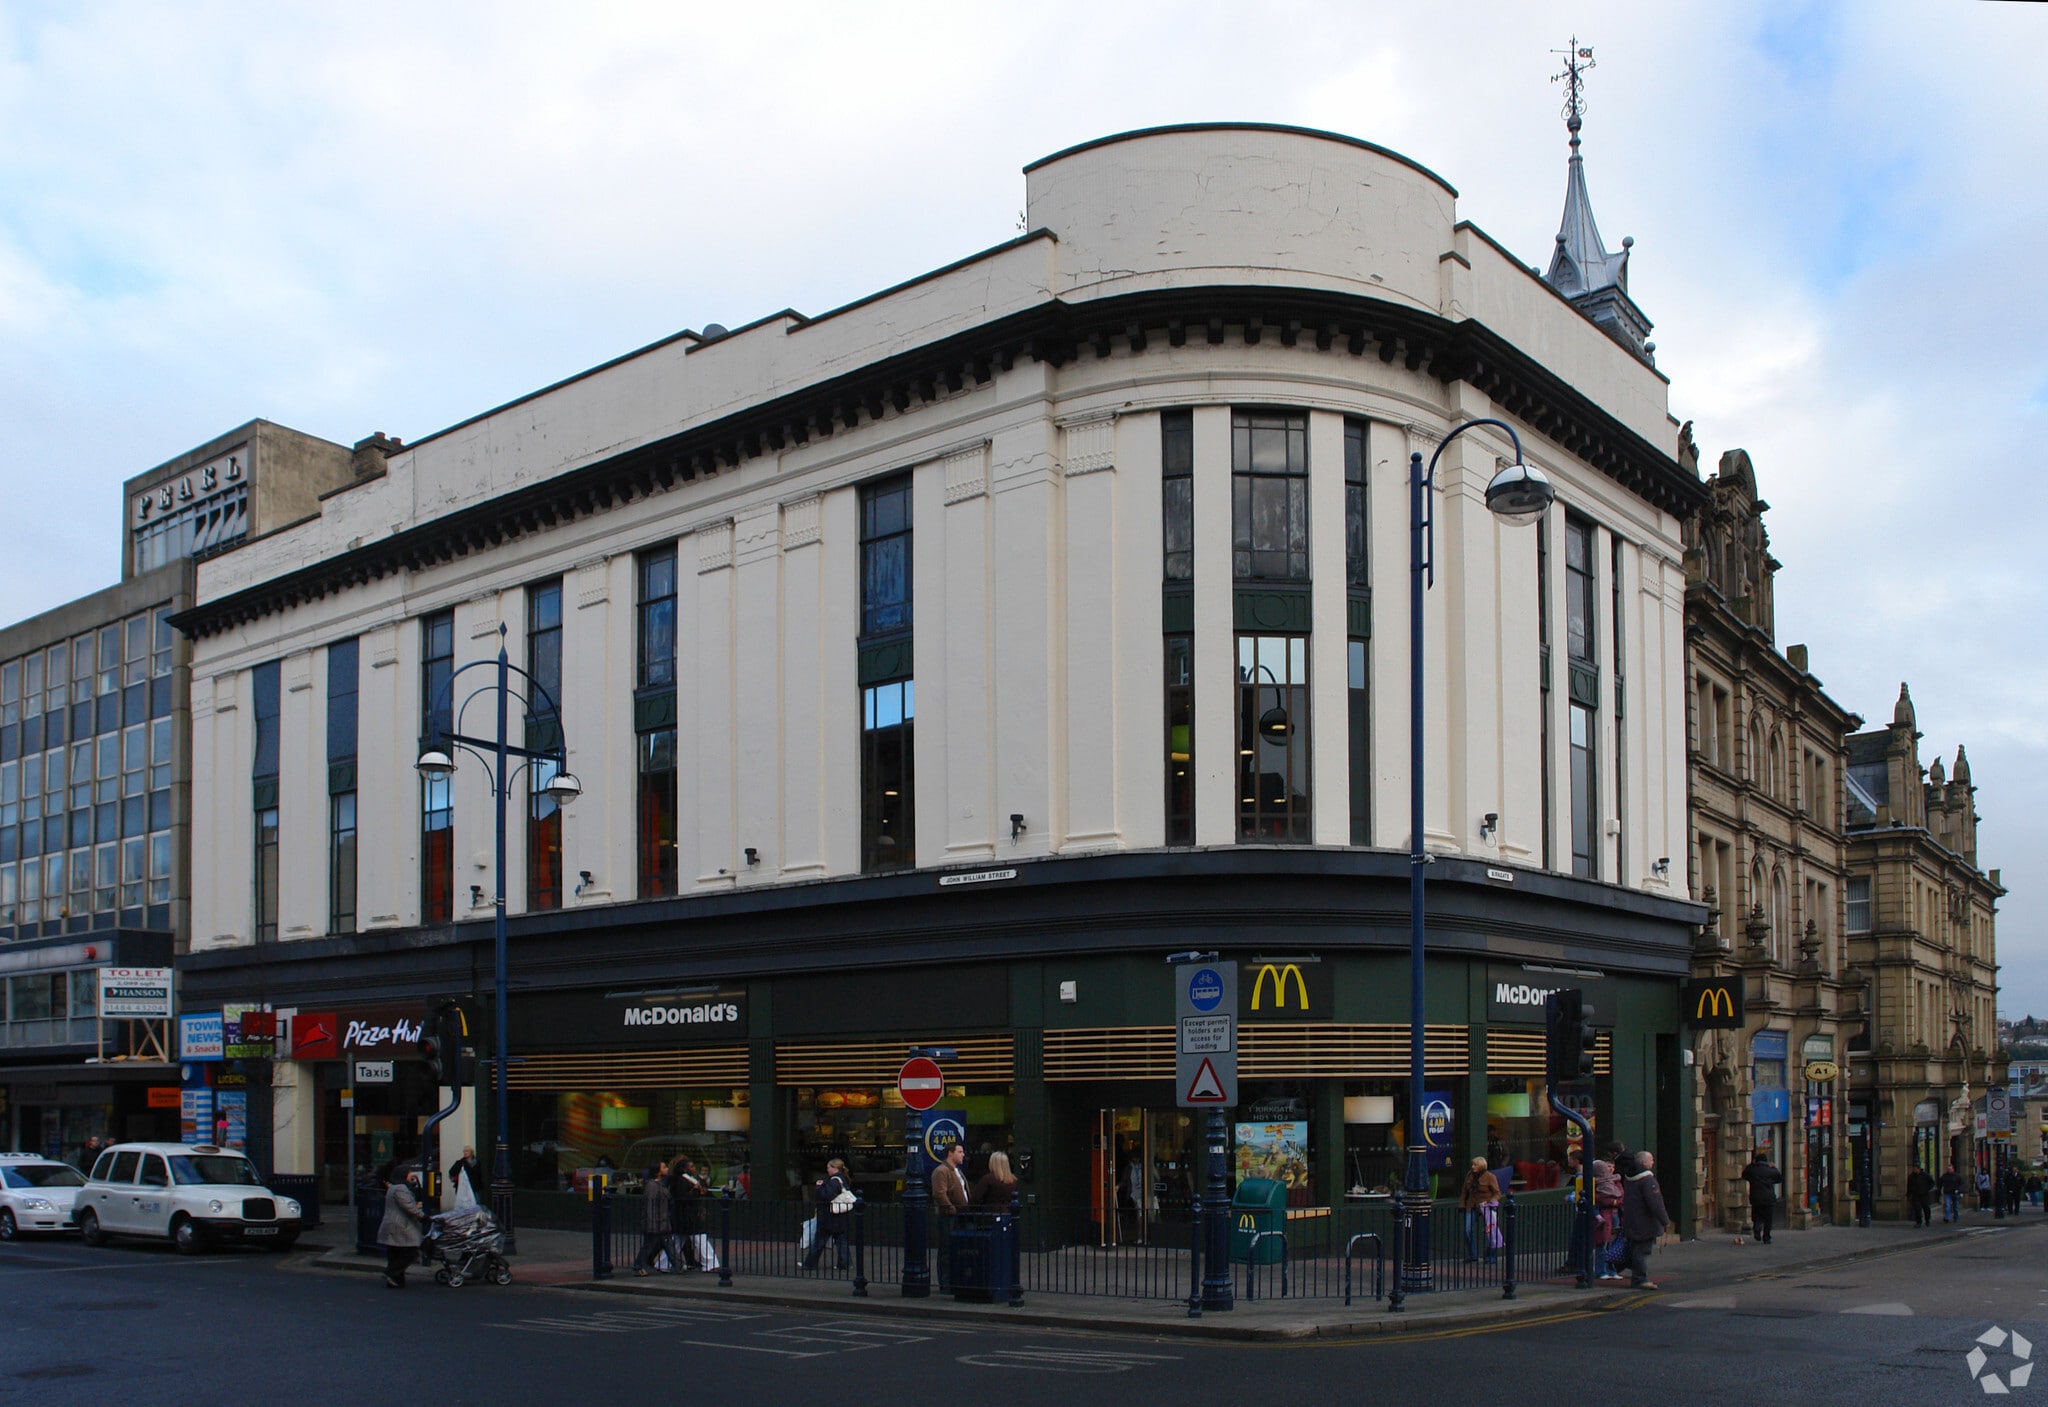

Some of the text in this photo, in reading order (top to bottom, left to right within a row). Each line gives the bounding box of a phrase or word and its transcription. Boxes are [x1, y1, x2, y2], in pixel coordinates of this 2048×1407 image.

[138, 456, 241, 519] PEARL
[108, 969, 164, 977] TO LET
[119, 988, 165, 997] HANSON
[1496, 983, 1570, 1005] McDon
[624, 1003, 738, 1026] McDonald's
[186, 1021, 223, 1031] TOWN
[1207, 1018, 1228, 1026] permit
[187, 1032, 223, 1044] NEWS
[343, 1020, 391, 1049] Pizza
[194, 1045, 220, 1053] Snacks
[359, 1066, 390, 1078] Taxis
[1435, 1117, 1445, 1127] AM
[933, 1136, 956, 1144] 4 AM
